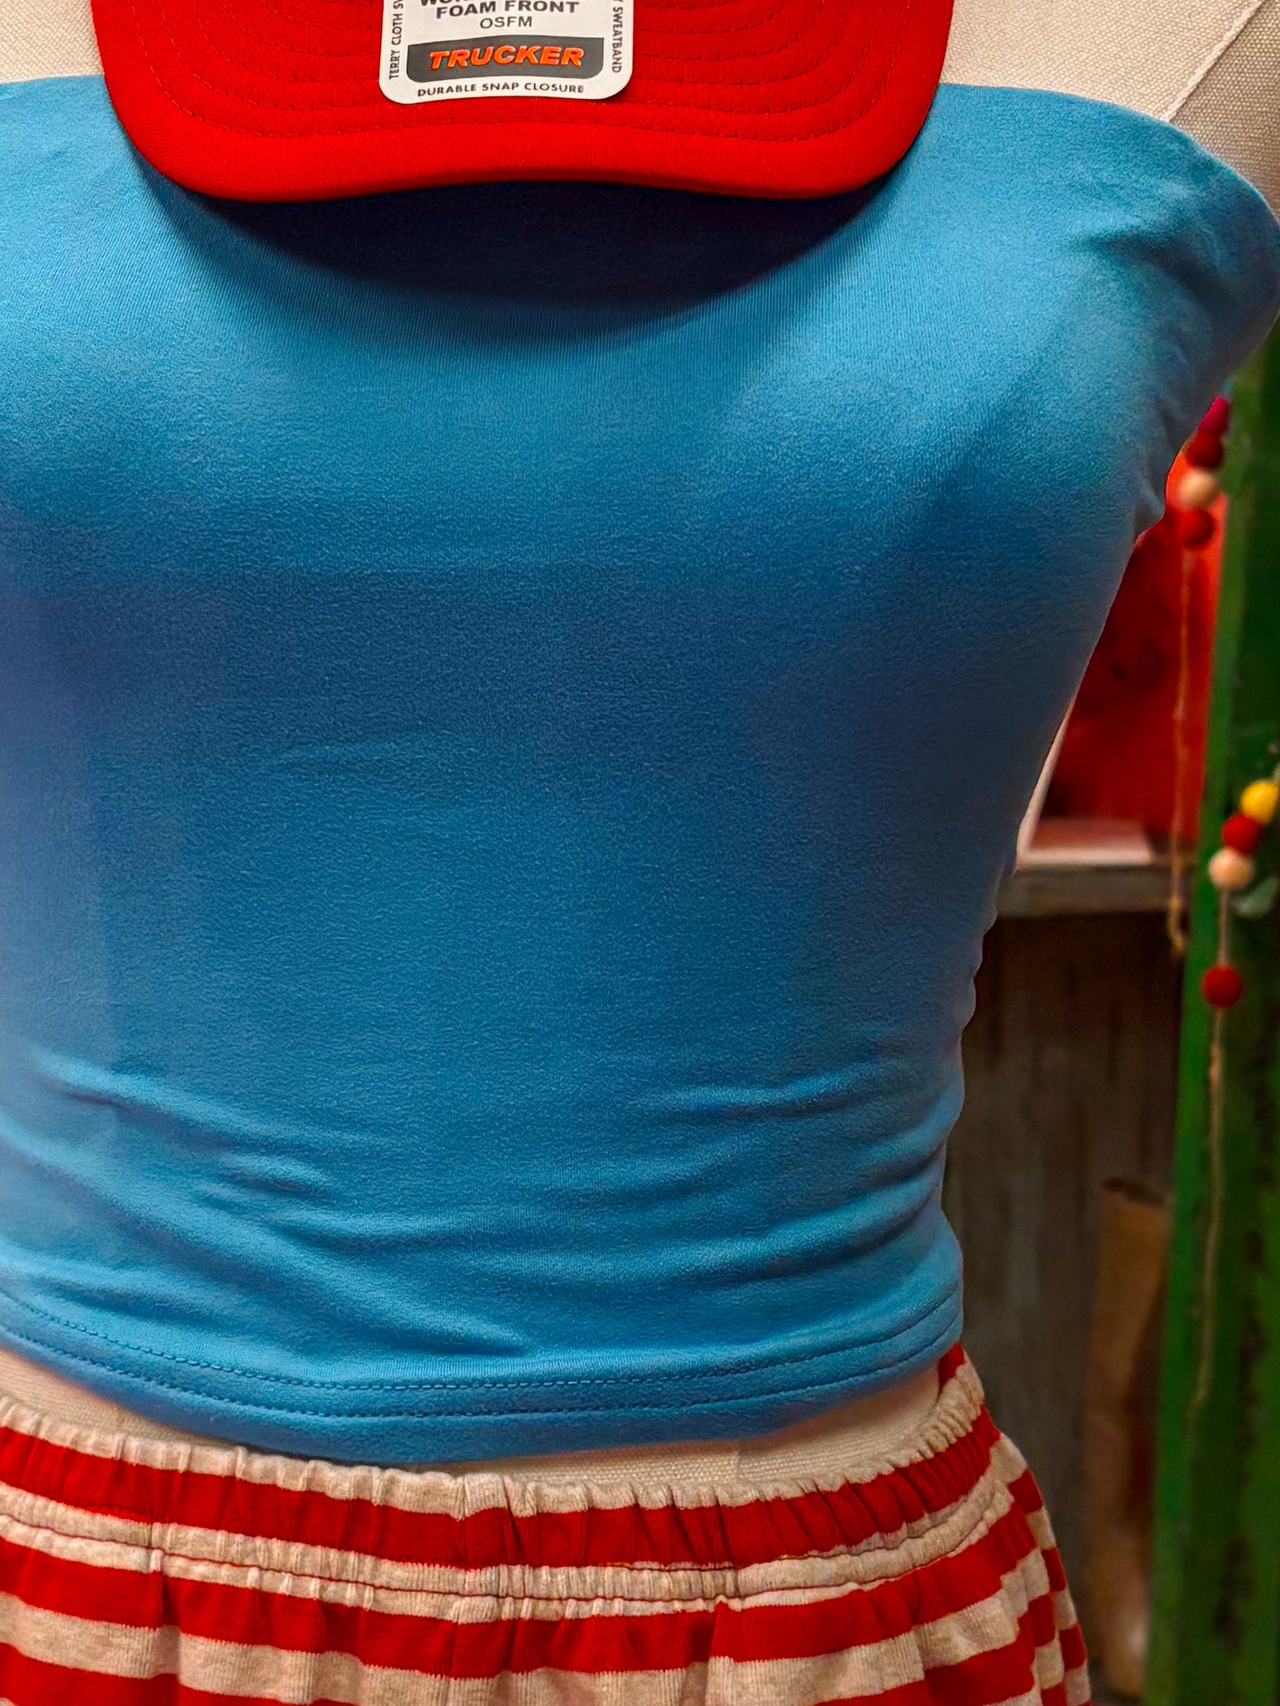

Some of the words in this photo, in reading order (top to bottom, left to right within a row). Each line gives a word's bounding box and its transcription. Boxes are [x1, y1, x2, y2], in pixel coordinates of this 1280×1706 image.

[436, 0, 496, 19] FOAM
[504, 0, 580, 13] FRONT
[392, 13, 403, 46] CLOTH
[480, 16, 533, 29] OSFM
[611, 6, 623, 73] SWEATBAND
[389, 50, 400, 80] TERRY
[429, 45, 584, 70] TRUCKER
[418, 83, 477, 97] DURABLE
[482, 82, 519, 92] SNAP
[524, 82, 584, 94] CLOSURE
